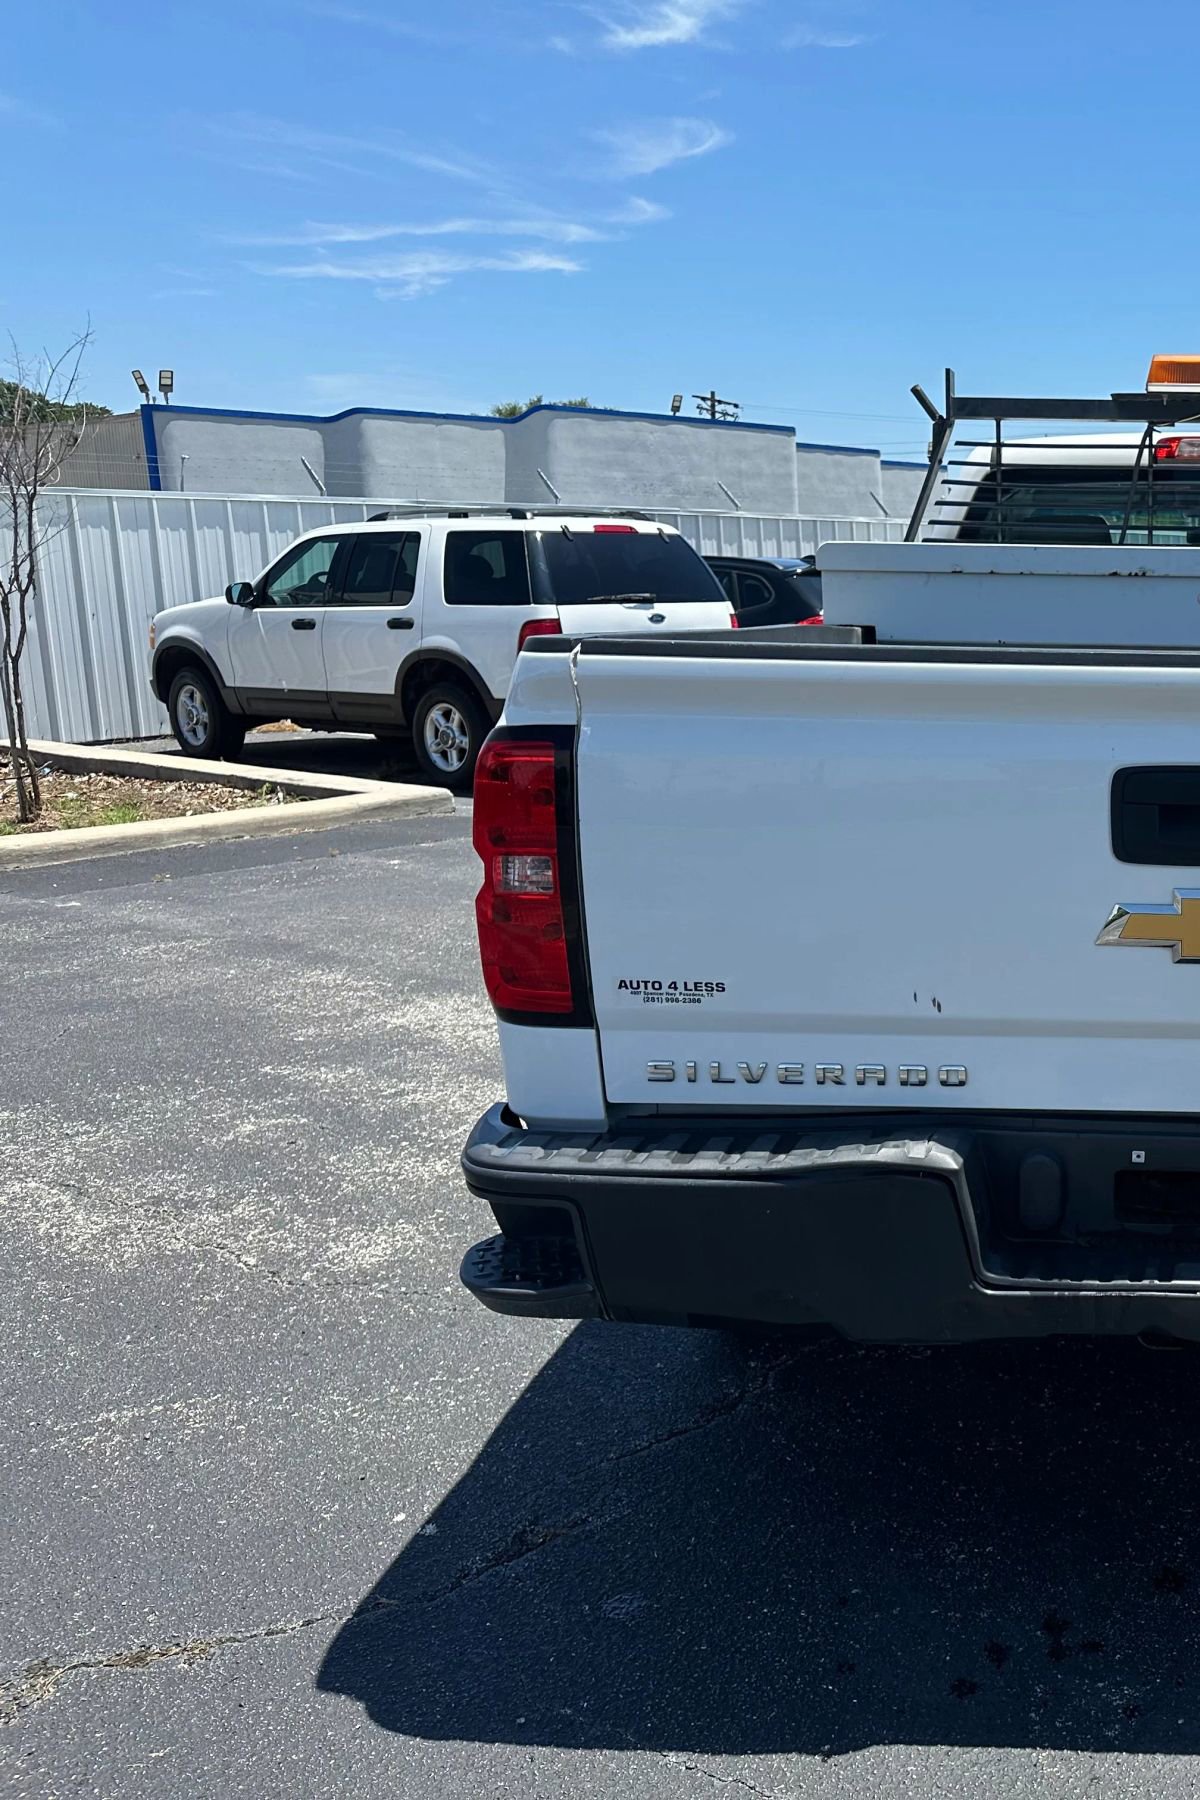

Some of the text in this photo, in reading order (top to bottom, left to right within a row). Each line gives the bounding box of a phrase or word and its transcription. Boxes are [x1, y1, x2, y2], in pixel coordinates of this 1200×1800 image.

[617, 979, 726, 993] AUTO 4 LESS
[643, 996, 663, 1004] (281)
[647, 1060, 967, 1087] SILVERADO
